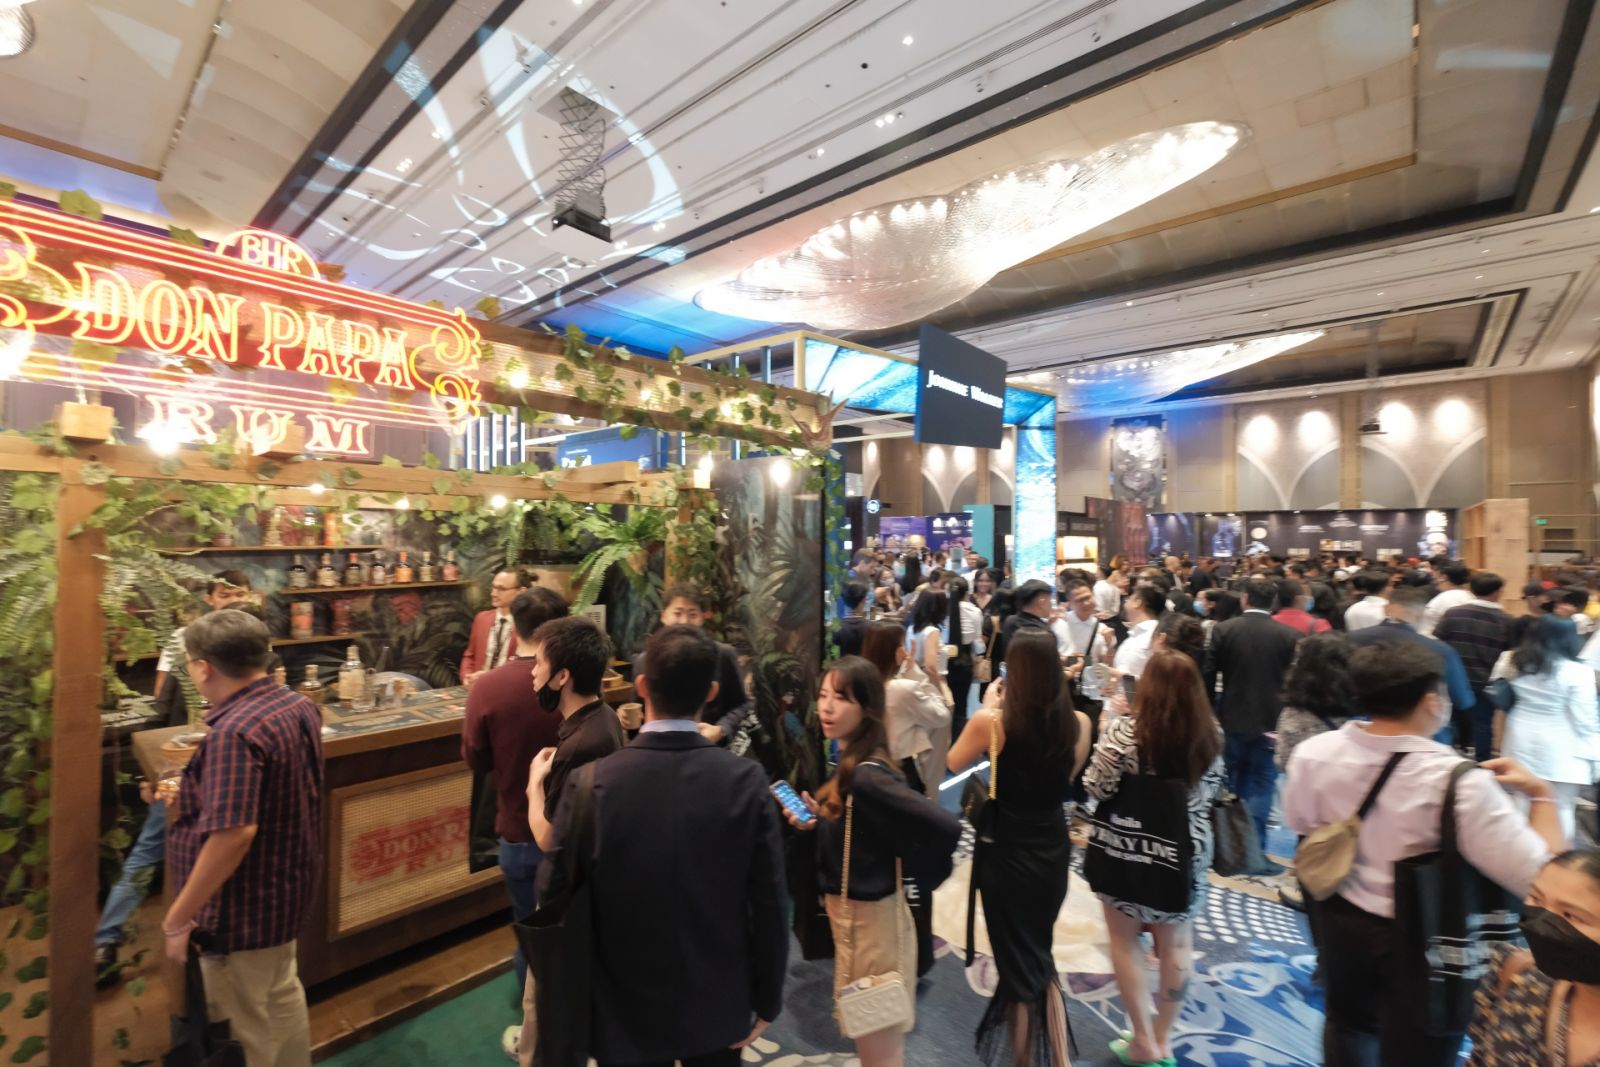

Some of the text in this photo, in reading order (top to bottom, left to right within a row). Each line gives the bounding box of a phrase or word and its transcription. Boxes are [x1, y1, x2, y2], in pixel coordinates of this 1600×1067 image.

[241, 234, 303, 274] BHR
[72, 261, 415, 390] DON PAPA
[136, 394, 370, 456] RUM
